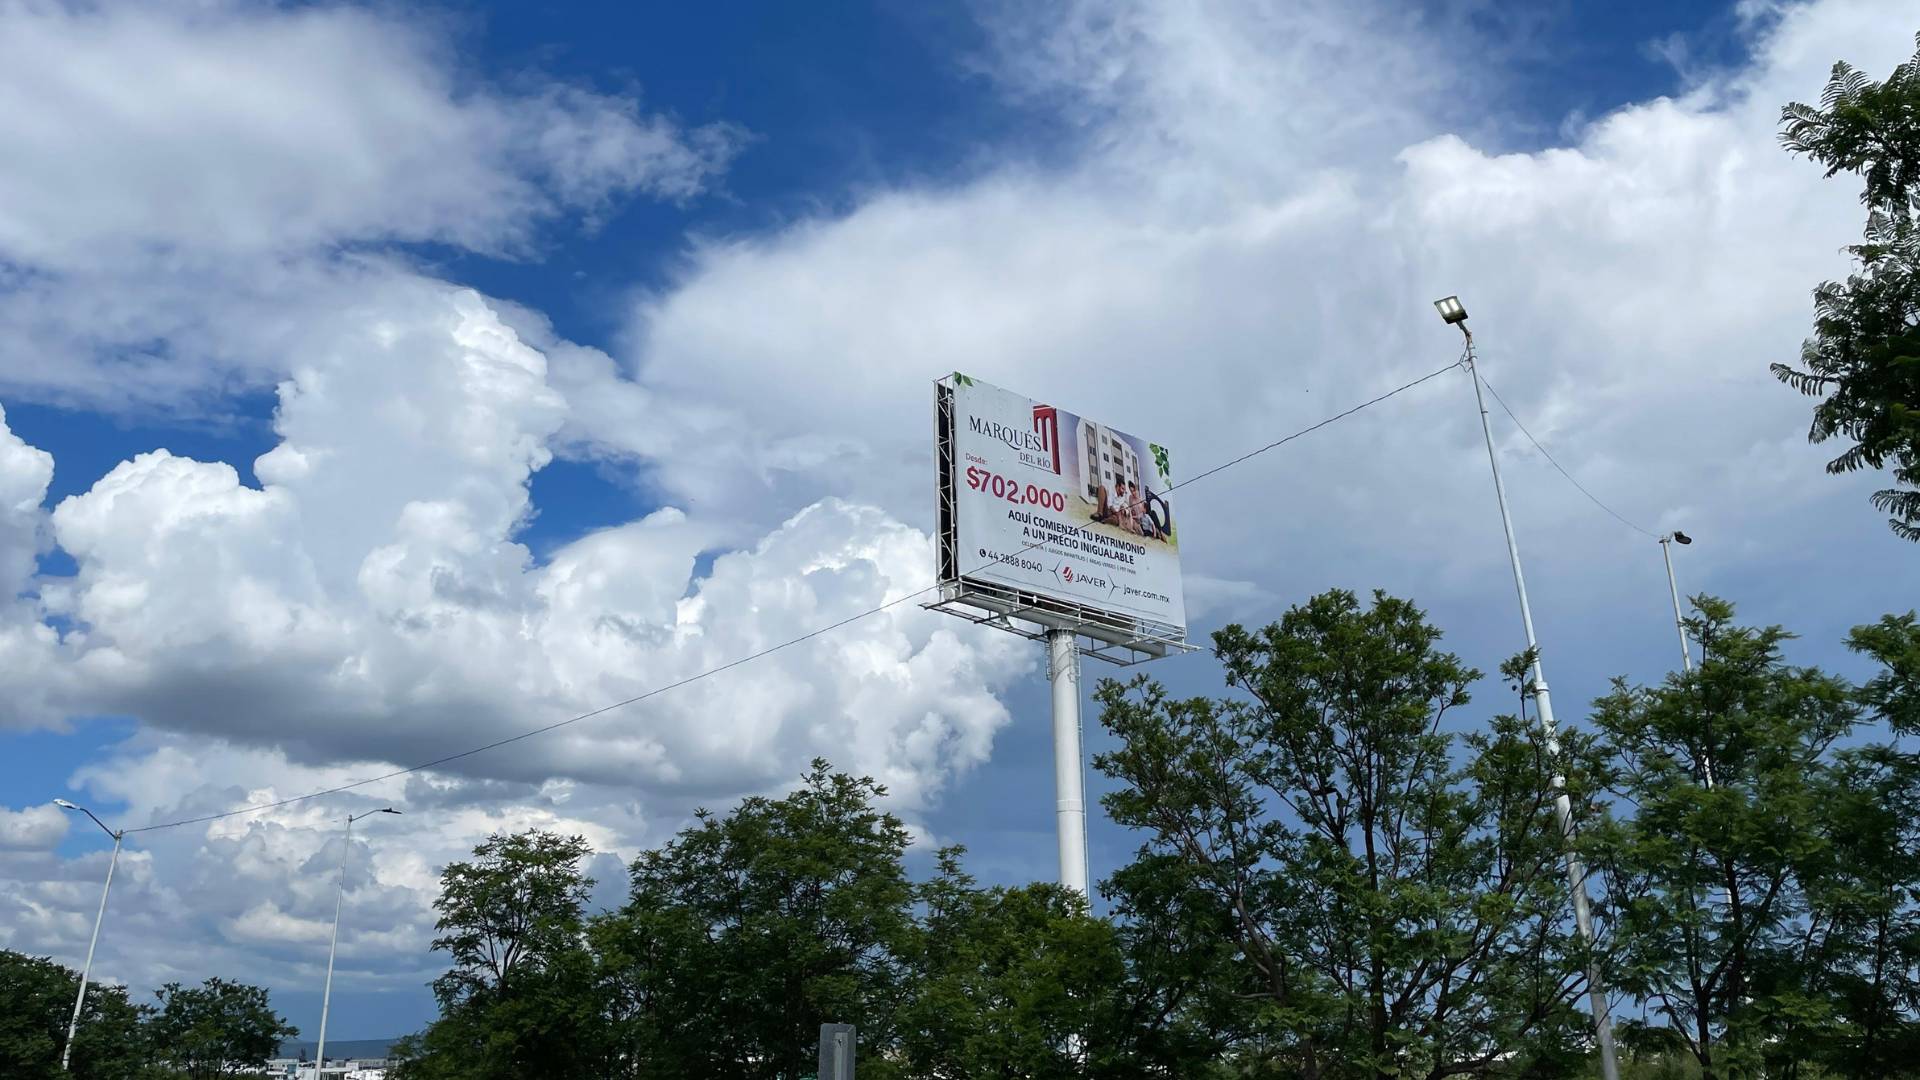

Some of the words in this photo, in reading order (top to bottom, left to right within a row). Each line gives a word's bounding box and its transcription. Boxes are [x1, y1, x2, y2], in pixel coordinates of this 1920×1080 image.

[969, 415, 1041, 452] MARQUÉS
[1020, 452, 1035, 464] DEL
[1037, 457, 1051, 468] RÍO
[1008, 510, 1031, 524] AQUÍ
[1033, 516, 1079, 537] COMIENZA
[1081, 529, 1093, 541] TU
[1095, 534, 1146, 555] PATRIMONIO
[1023, 527, 1030, 537] A
[1032, 530, 1045, 542] UN
[1047, 533, 1079, 550] PRECIO
[1080, 541, 1134, 565] INIGUALABLE
[988, 552, 998, 562] 44
[1000, 554, 1020, 568] 2888
[1021, 559, 1043, 573] 8040
[1075, 573, 1106, 589] JAVER
[1123, 584, 1170, 604] javer.com.mx
